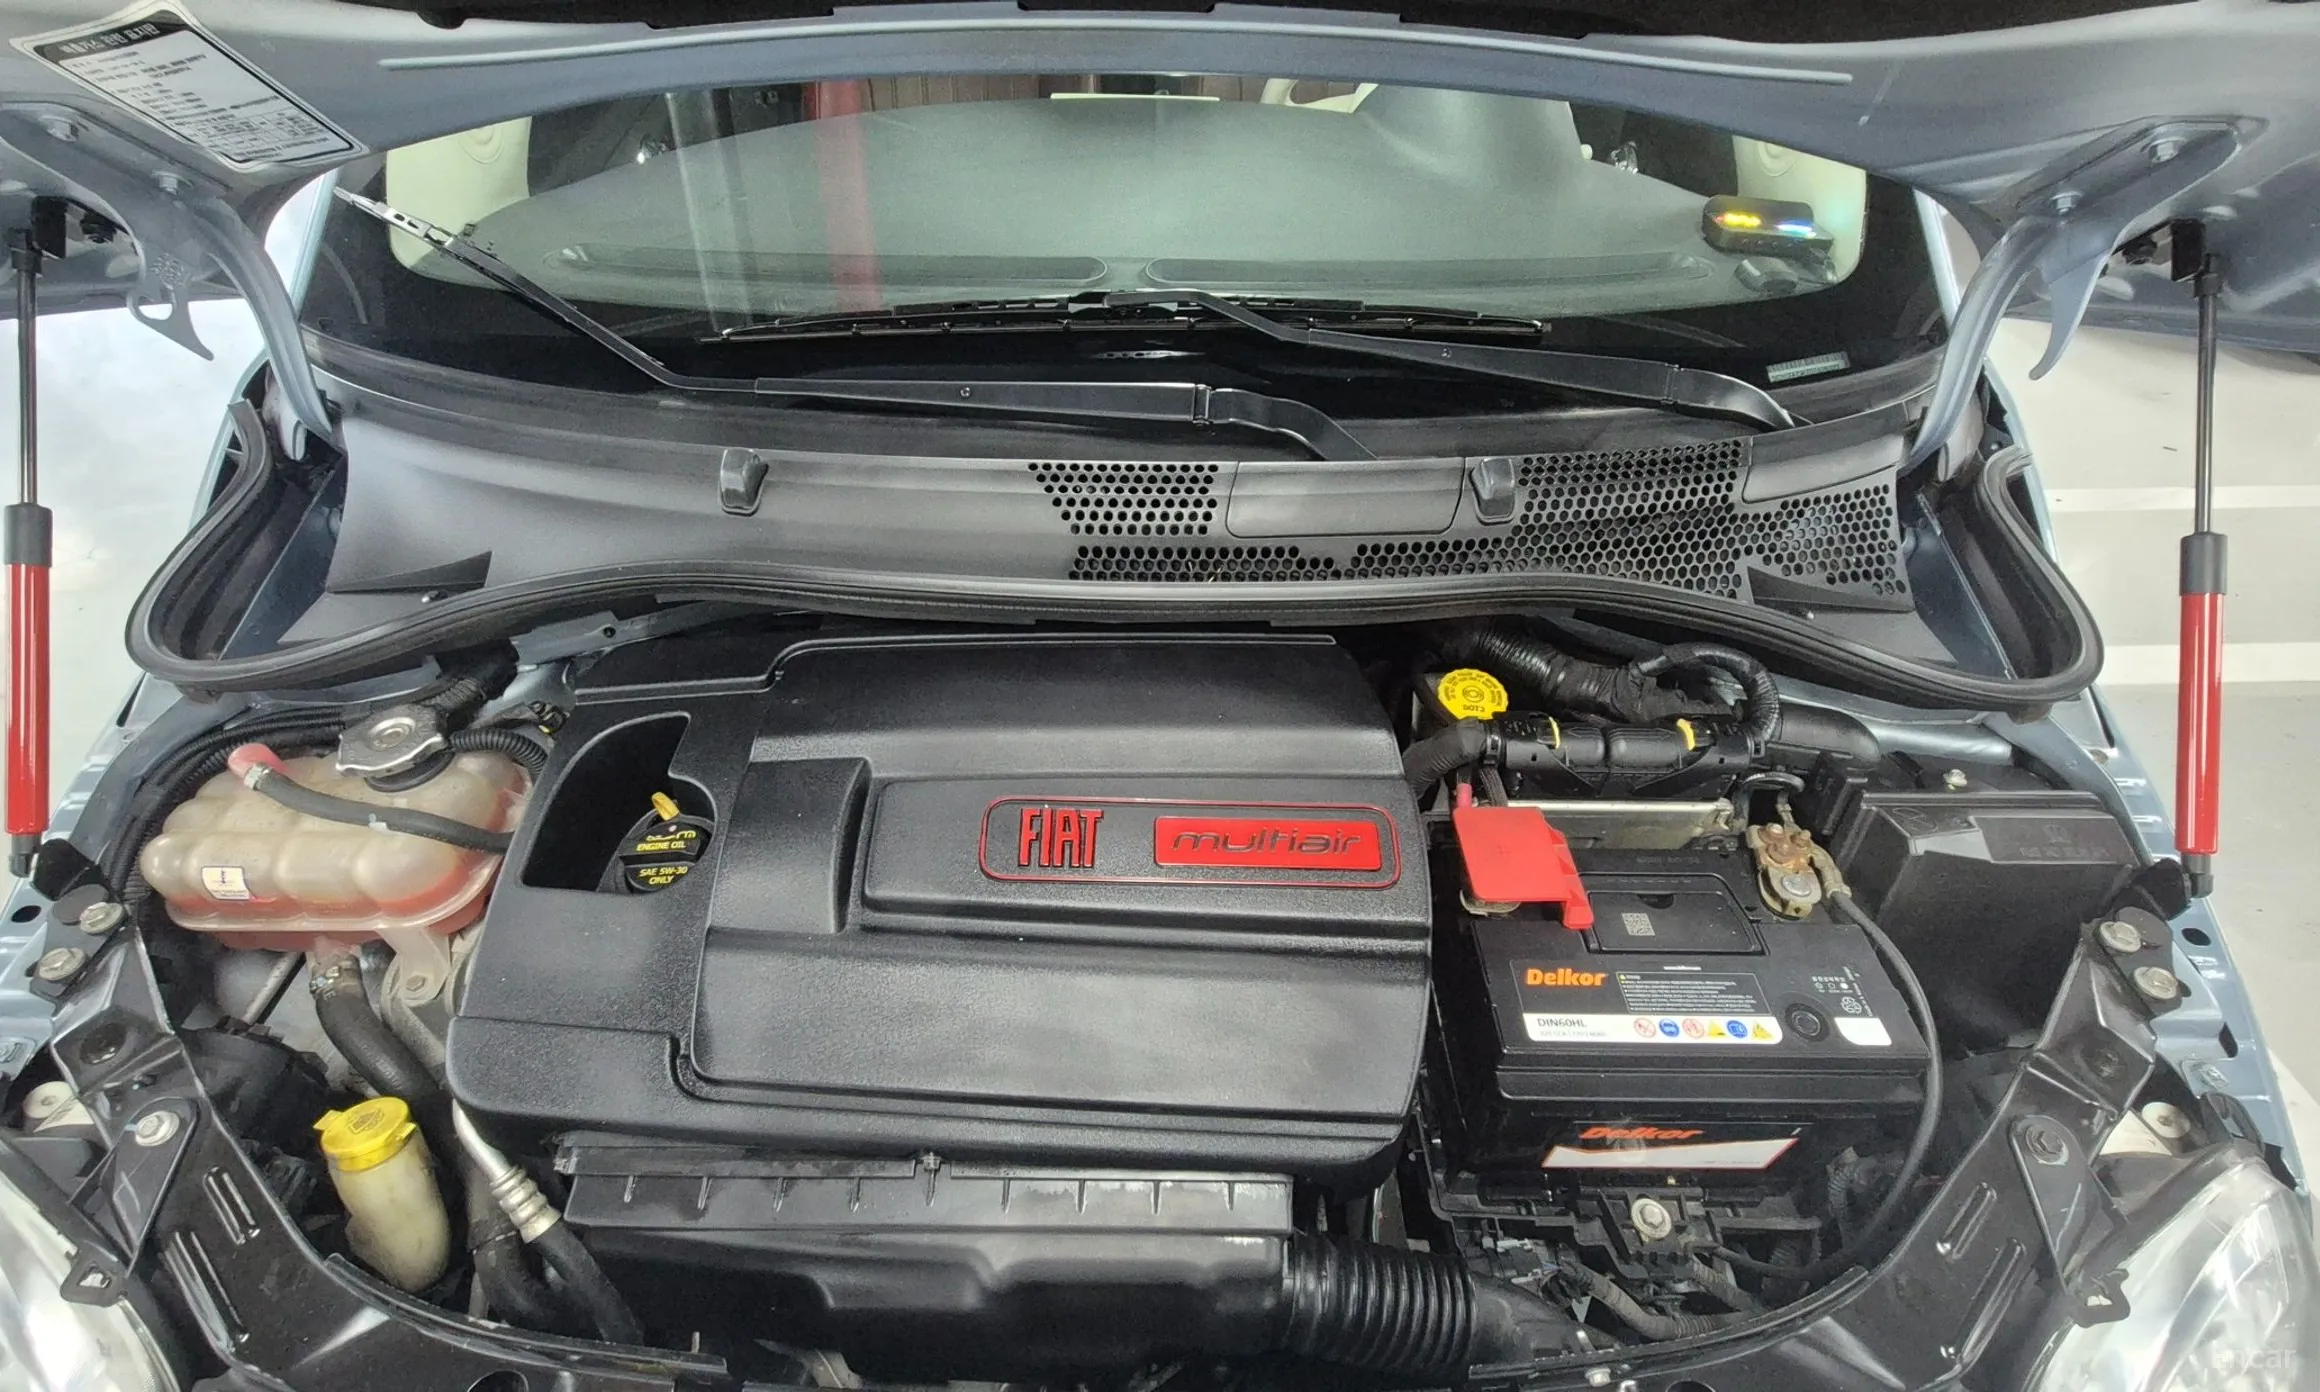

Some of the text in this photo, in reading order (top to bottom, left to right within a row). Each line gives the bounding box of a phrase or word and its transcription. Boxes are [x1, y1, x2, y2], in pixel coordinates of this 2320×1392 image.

[1017, 807, 1104, 868] FIAT
[1172, 825, 1361, 856] multiair
[637, 840, 686, 851] ENGINE OIL
[639, 866, 688, 877] SAE 5W-30
[648, 875, 675, 885] ONLY
[1526, 967, 1606, 986] Delkor
[1537, 1018, 1587, 1028] DIN60HL
[1579, 1126, 1704, 1139] Delkor
